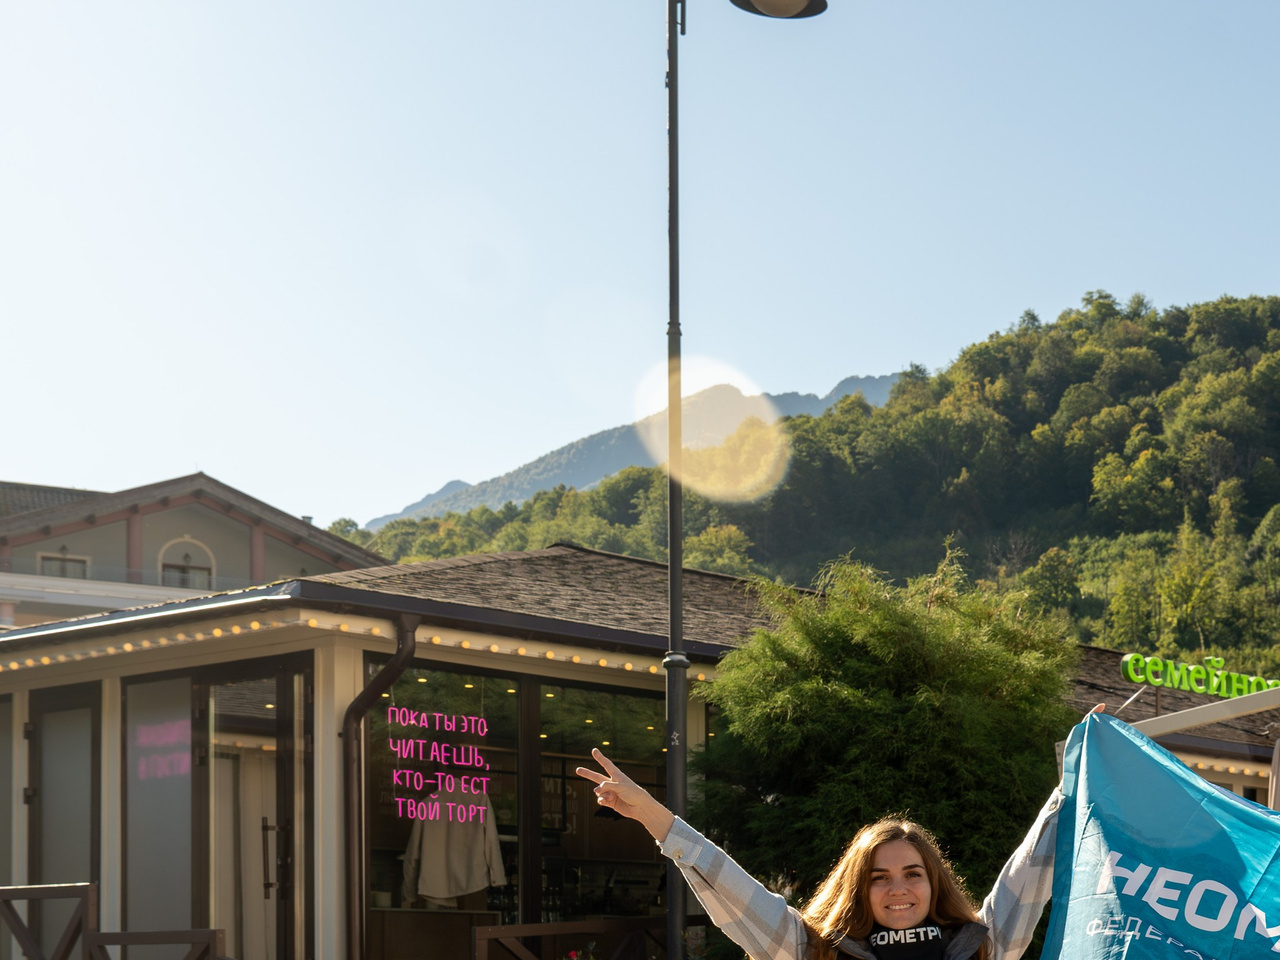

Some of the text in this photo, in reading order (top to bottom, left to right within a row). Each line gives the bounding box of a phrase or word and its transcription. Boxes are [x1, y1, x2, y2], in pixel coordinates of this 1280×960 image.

[388, 707, 487, 737] ПОКА ТЫ ЭТО
[389, 738, 490, 771] ЧИТАЕШЬ,
[393, 769, 455, 793] КТО-ТО
[461, 775, 490, 795] ЕСТ
[395, 793, 487, 824] ТВОЙ ТОРТ
[869, 926, 942, 947] ЕОМЕТР
